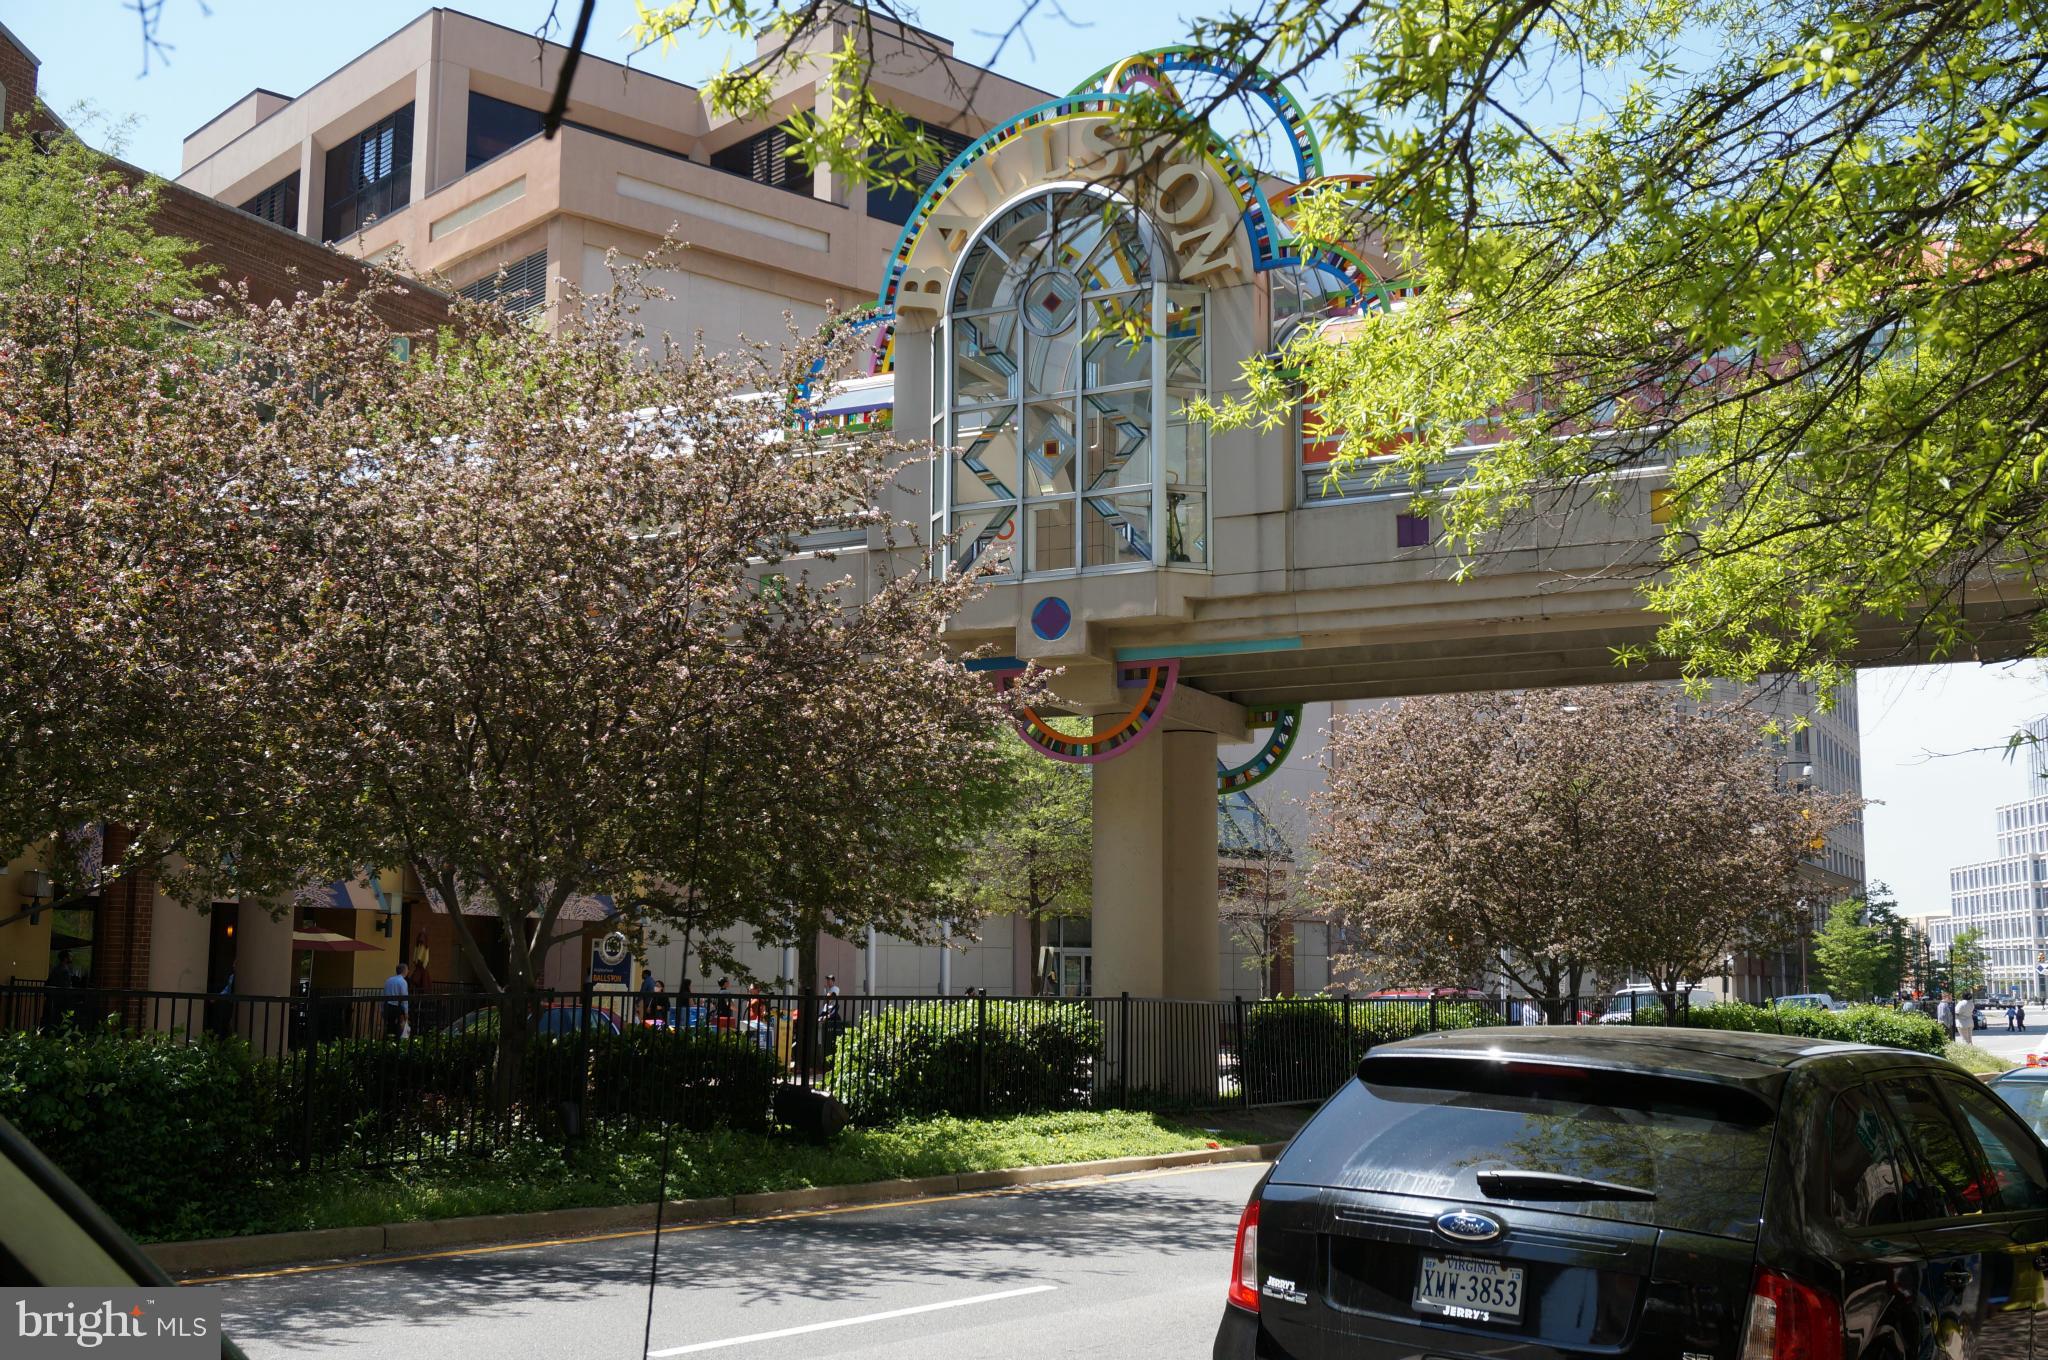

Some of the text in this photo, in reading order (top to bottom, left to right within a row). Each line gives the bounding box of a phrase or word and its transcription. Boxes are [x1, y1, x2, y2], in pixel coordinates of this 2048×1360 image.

[896, 120, 1242, 319] BALLSTON
[1449, 1216, 1486, 1234] Ford
[1447, 1260, 1497, 1275] VIRGINIA
[1266, 1275, 1296, 1291] JERRY'S
[1422, 1269, 1518, 1307] XMW-3853
[1442, 1305, 1490, 1322] JERRY'S
